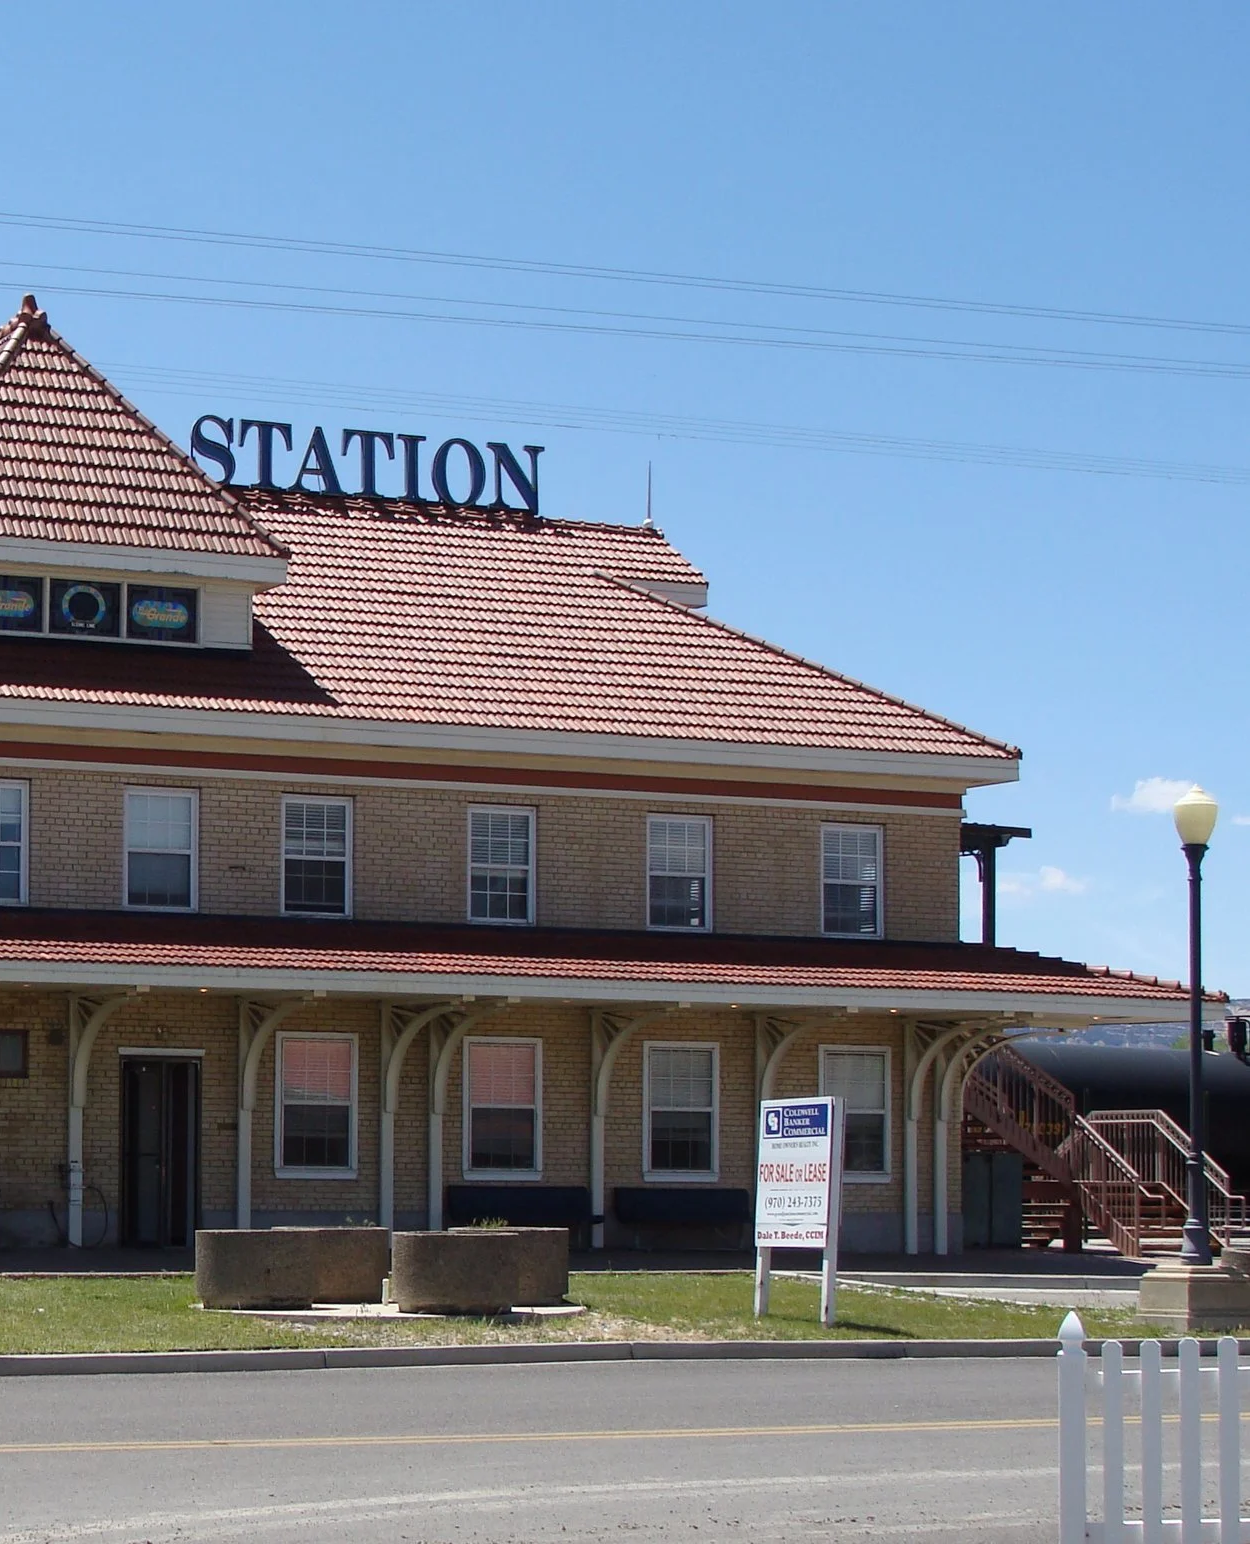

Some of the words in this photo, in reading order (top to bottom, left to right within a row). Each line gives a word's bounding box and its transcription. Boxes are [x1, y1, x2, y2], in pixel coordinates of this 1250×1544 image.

[190, 414, 545, 515] STATION
[783, 1118, 810, 1127] BANKER
[783, 1127, 826, 1136] COMMERCIAL
[760, 1164, 774, 1182] FOR
[775, 1164, 794, 1182] SALE
[795, 1168, 803, 1182] OR
[804, 1163, 827, 1182] LEASE
[765, 1196, 785, 1209] (970)
[787, 1195, 822, 1208] 243-7375
[758, 1231, 773, 1239] Dale
[781, 1231, 805, 1241] Beede,
